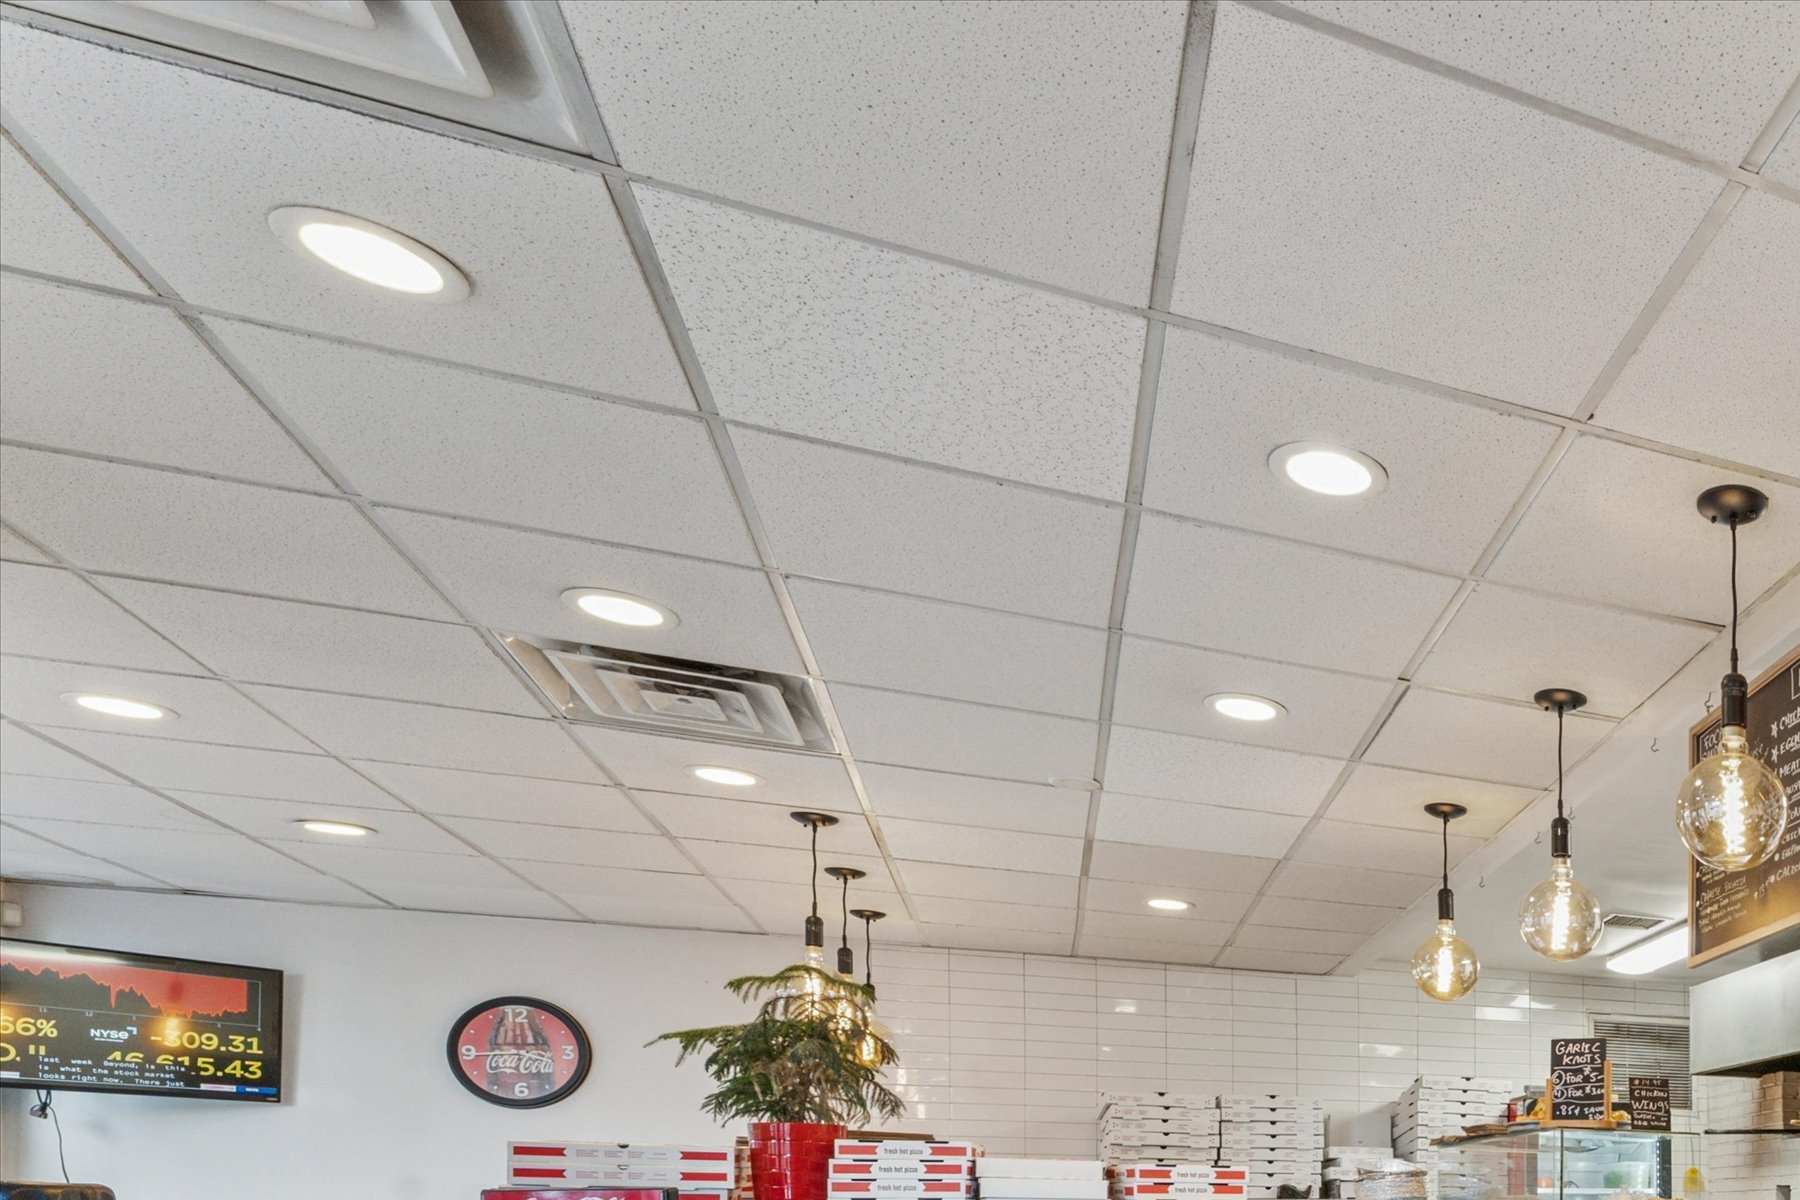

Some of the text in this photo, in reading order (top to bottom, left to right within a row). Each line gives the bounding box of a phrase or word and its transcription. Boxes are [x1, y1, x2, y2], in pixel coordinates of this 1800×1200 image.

[504, 1008, 529, 1023] 12
[461, 1045, 574, 1060] 9 3
[1555, 1041, 1600, 1055] GARLIC
[114, 1069, 140, 1077] stock
[514, 1082, 529, 1097] 6
